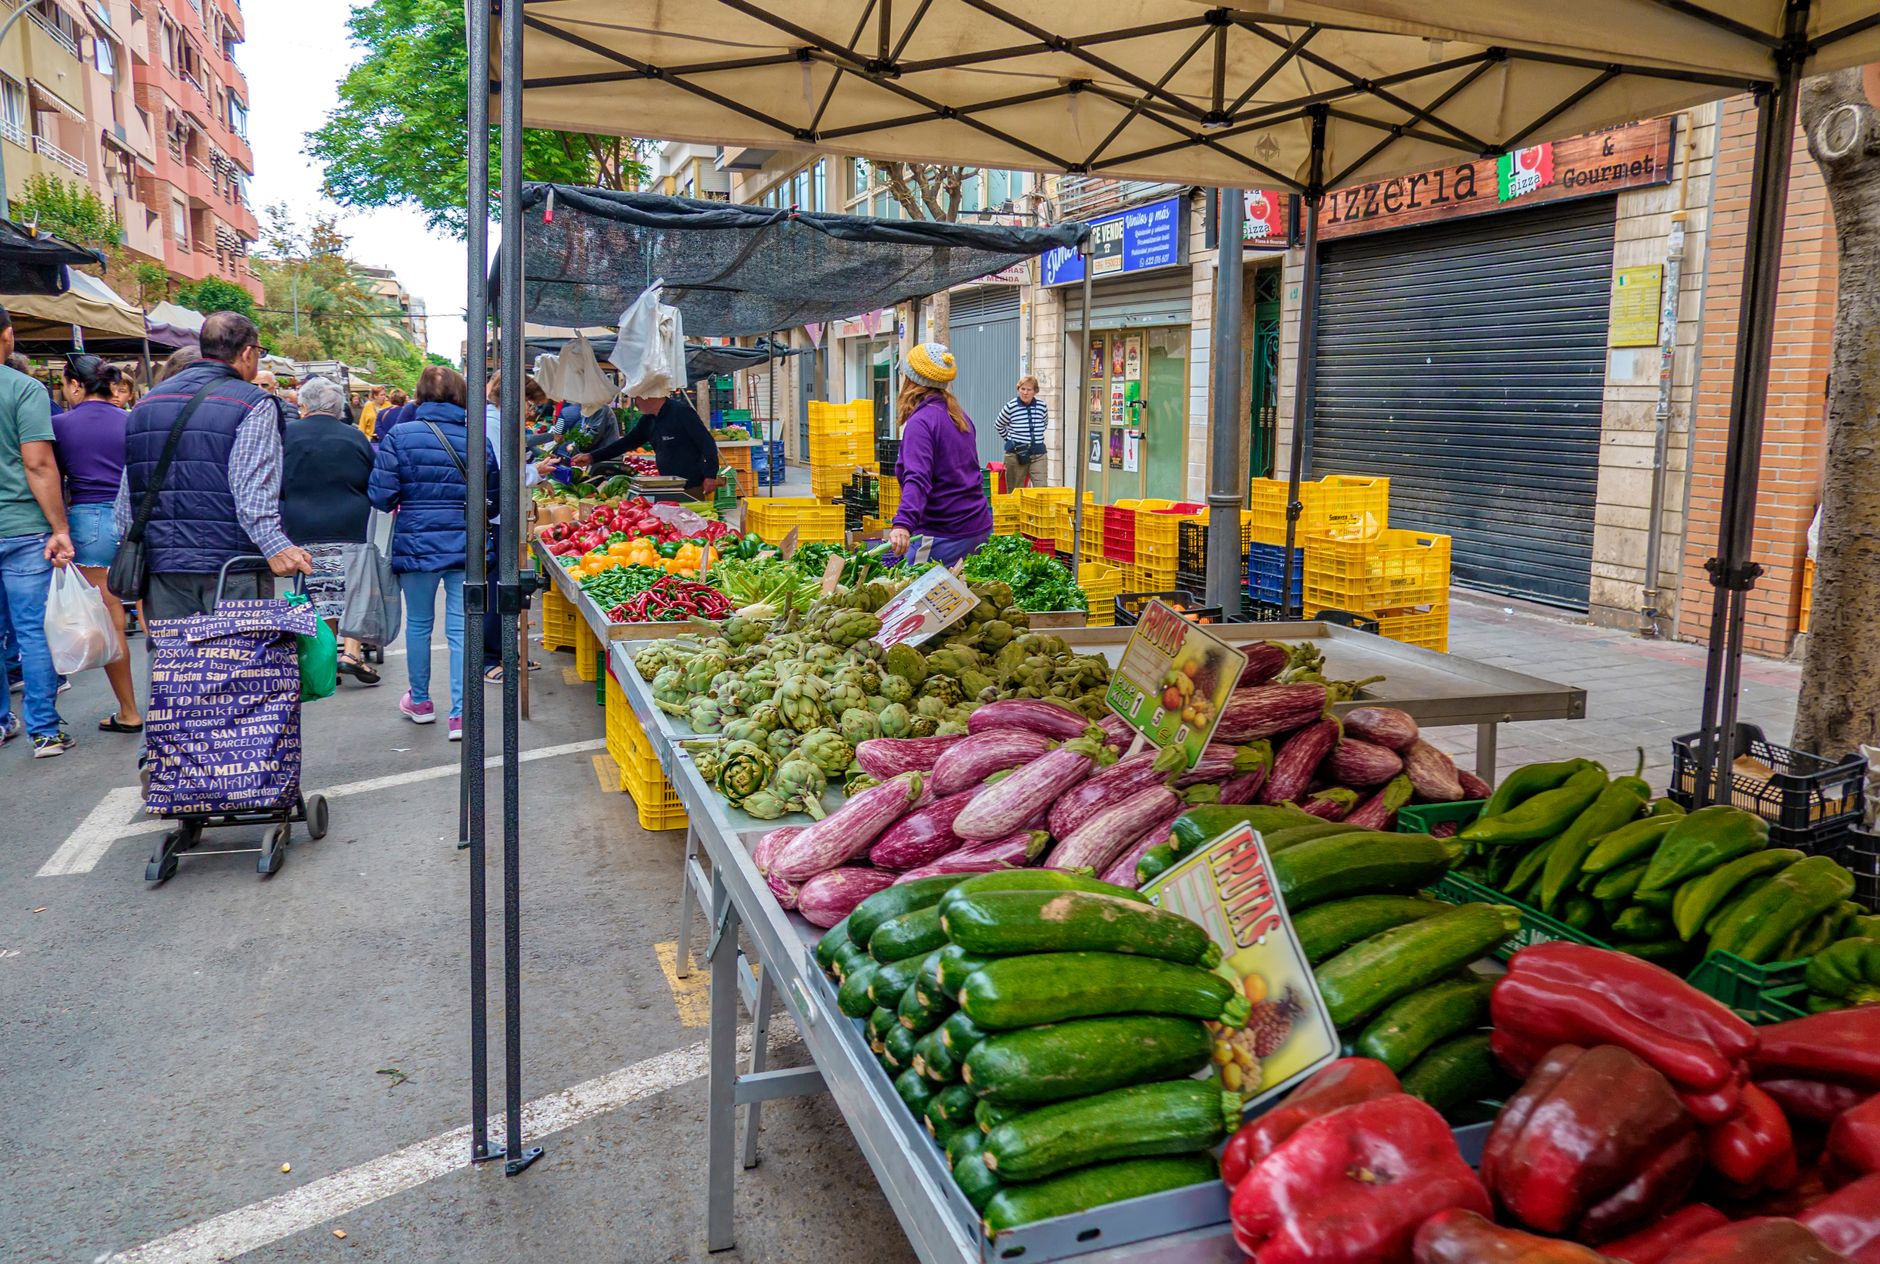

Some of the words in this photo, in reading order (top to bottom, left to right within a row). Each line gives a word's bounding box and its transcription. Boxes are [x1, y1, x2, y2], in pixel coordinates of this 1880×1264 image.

[1602, 136, 1614, 157] &
[1563, 154, 1654, 188] Gourmet
[1510, 173, 1540, 195] pizza
[1318, 163, 1477, 224] izzeria
[1101, 220, 1124, 243] VENDE
[190, 621, 230, 634] miami
[235, 619, 272, 627] SEVILLA
[1137, 602, 1190, 659] FRUTAS
[173, 671, 202, 682] boston
[198, 681, 260, 694] MILANO
[164, 694, 234, 707] TOKIO
[1111, 690, 1130, 711] KILO
[176, 706, 260, 718] frankfurt
[185, 718, 226, 728] moskva
[234, 713, 279, 725] venezia
[210, 729, 237, 739] SAN
[214, 736, 273, 749] BARCELONA
[187, 751, 227, 765] NEW
[214, 760, 280, 776] MILANO
[177, 779, 207, 789] PISA
[210, 774, 261, 790] MIAMI
[227, 785, 279, 800] amsterdam
[1208, 829, 1281, 949] FRUTAS
